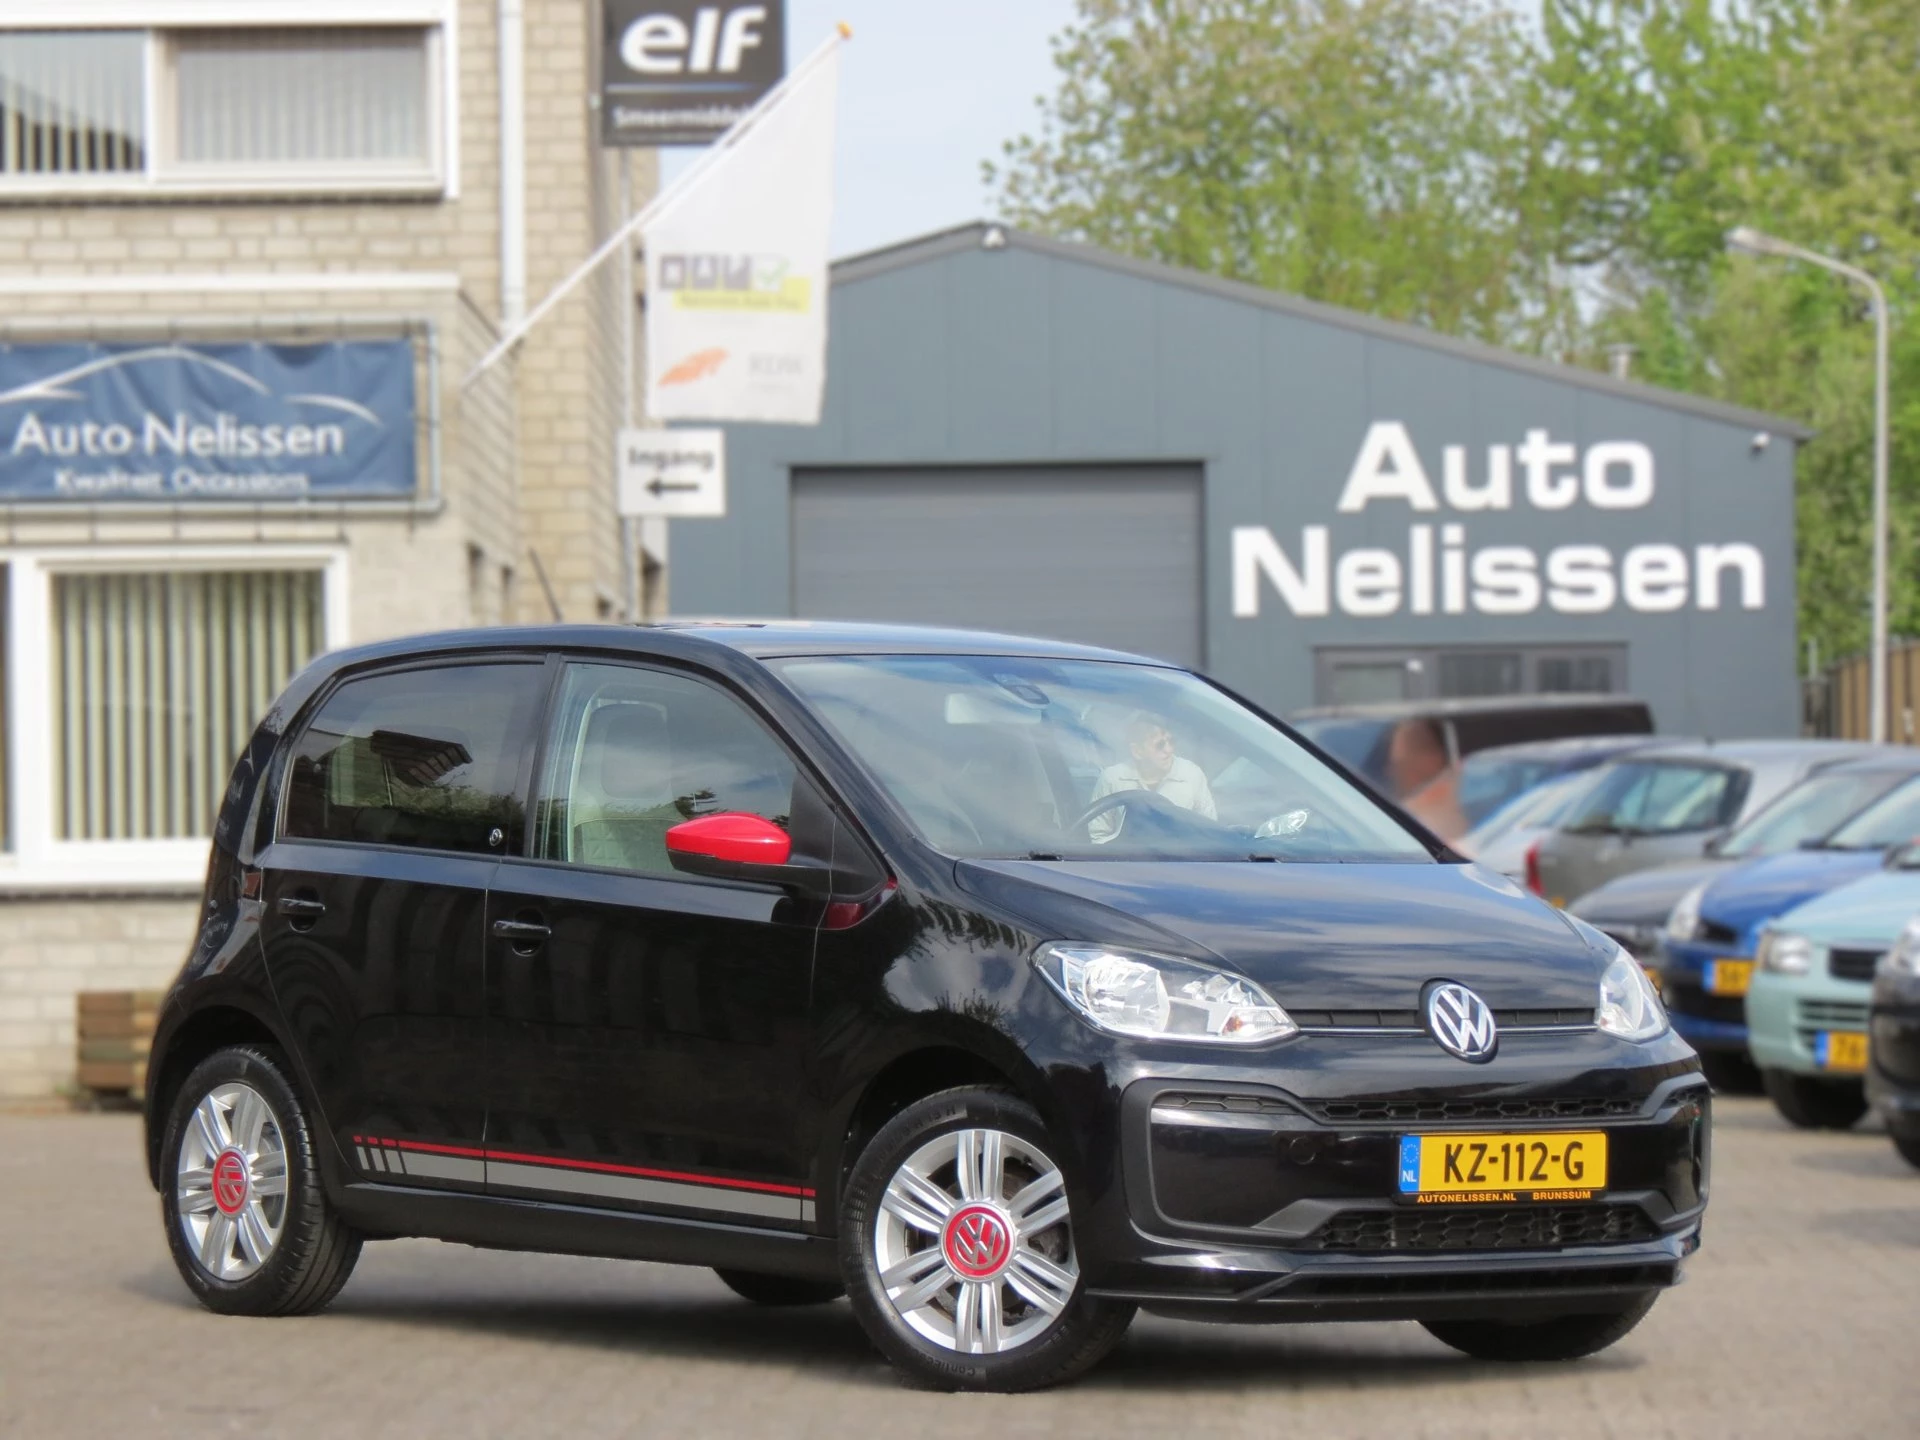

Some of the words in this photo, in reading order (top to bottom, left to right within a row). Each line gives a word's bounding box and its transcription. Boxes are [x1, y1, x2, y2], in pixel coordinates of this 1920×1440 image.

[620, 5, 767, 73] elf
[10, 411, 134, 456] Auto
[143, 411, 345, 457] Nelissen
[628, 446, 716, 472] Ingang
[1337, 420, 1655, 512] Auto
[1231, 523, 1765, 617] Nelissen
[1402, 1169, 1417, 1183] NL
[1444, 1140, 1584, 1183] KZ-112-G
[1417, 1192, 1517, 1203] AUTONELISSEN.NL
[1532, 1190, 1591, 1200] BRUNSSUM
